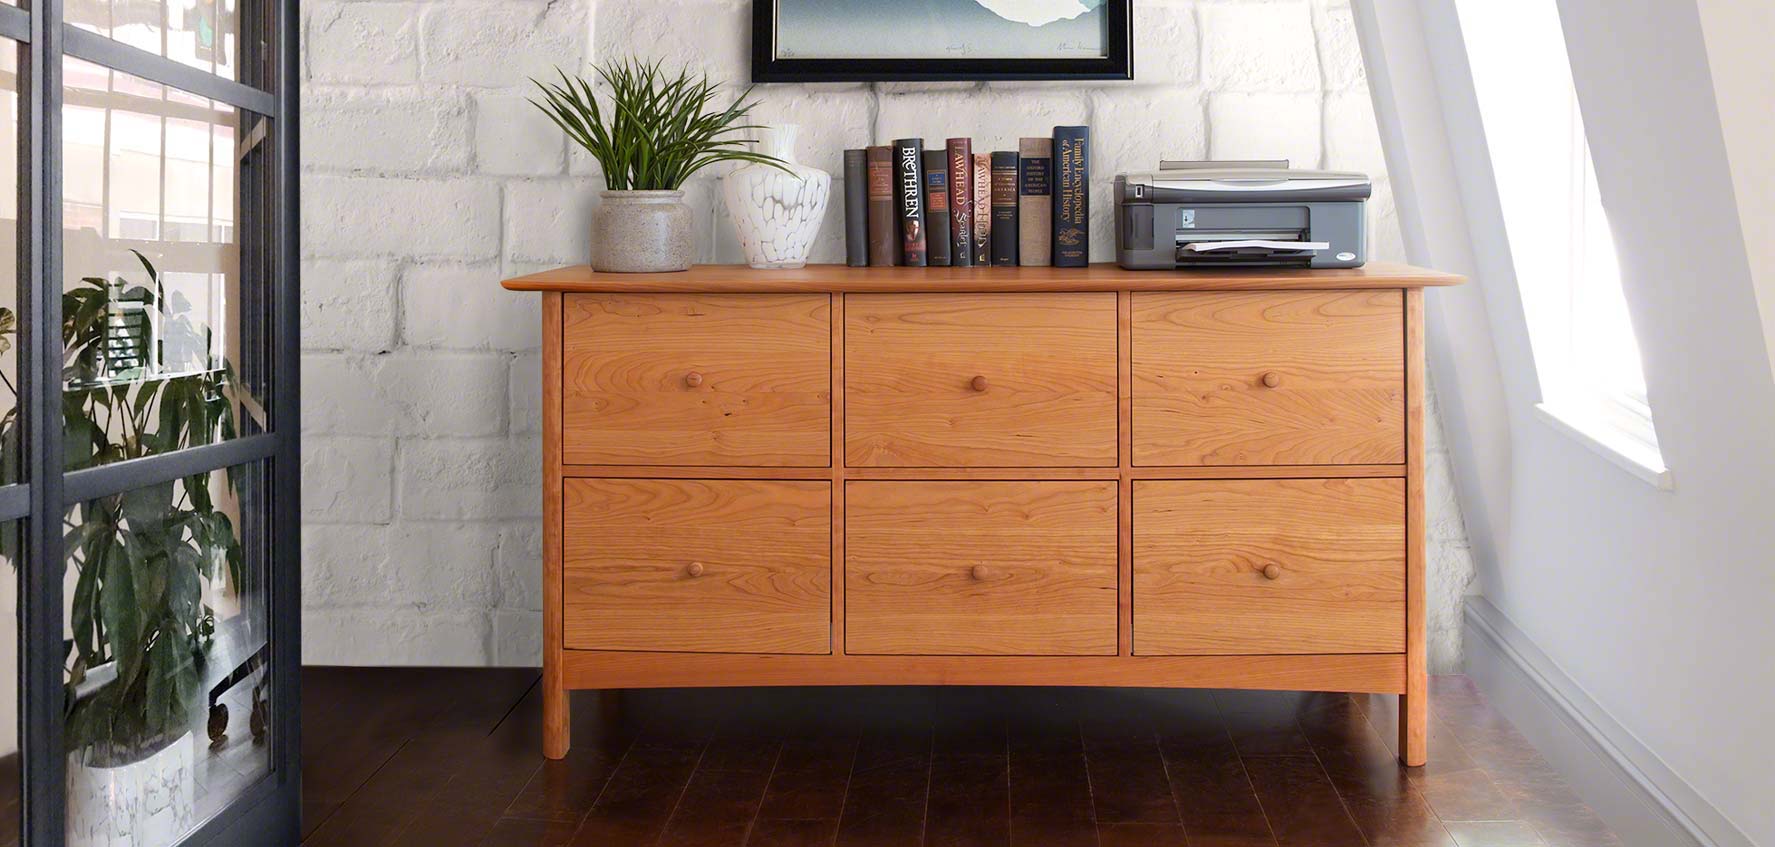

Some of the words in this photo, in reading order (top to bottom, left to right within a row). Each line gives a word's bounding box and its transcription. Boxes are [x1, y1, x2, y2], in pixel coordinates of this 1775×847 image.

[1062, 147, 1072, 188] American
[1072, 138, 1084, 166] Family
[954, 146, 967, 205] LAWHEAD
[1072, 167, 1084, 224] Encyclopedia
[1060, 189, 1072, 222] History
